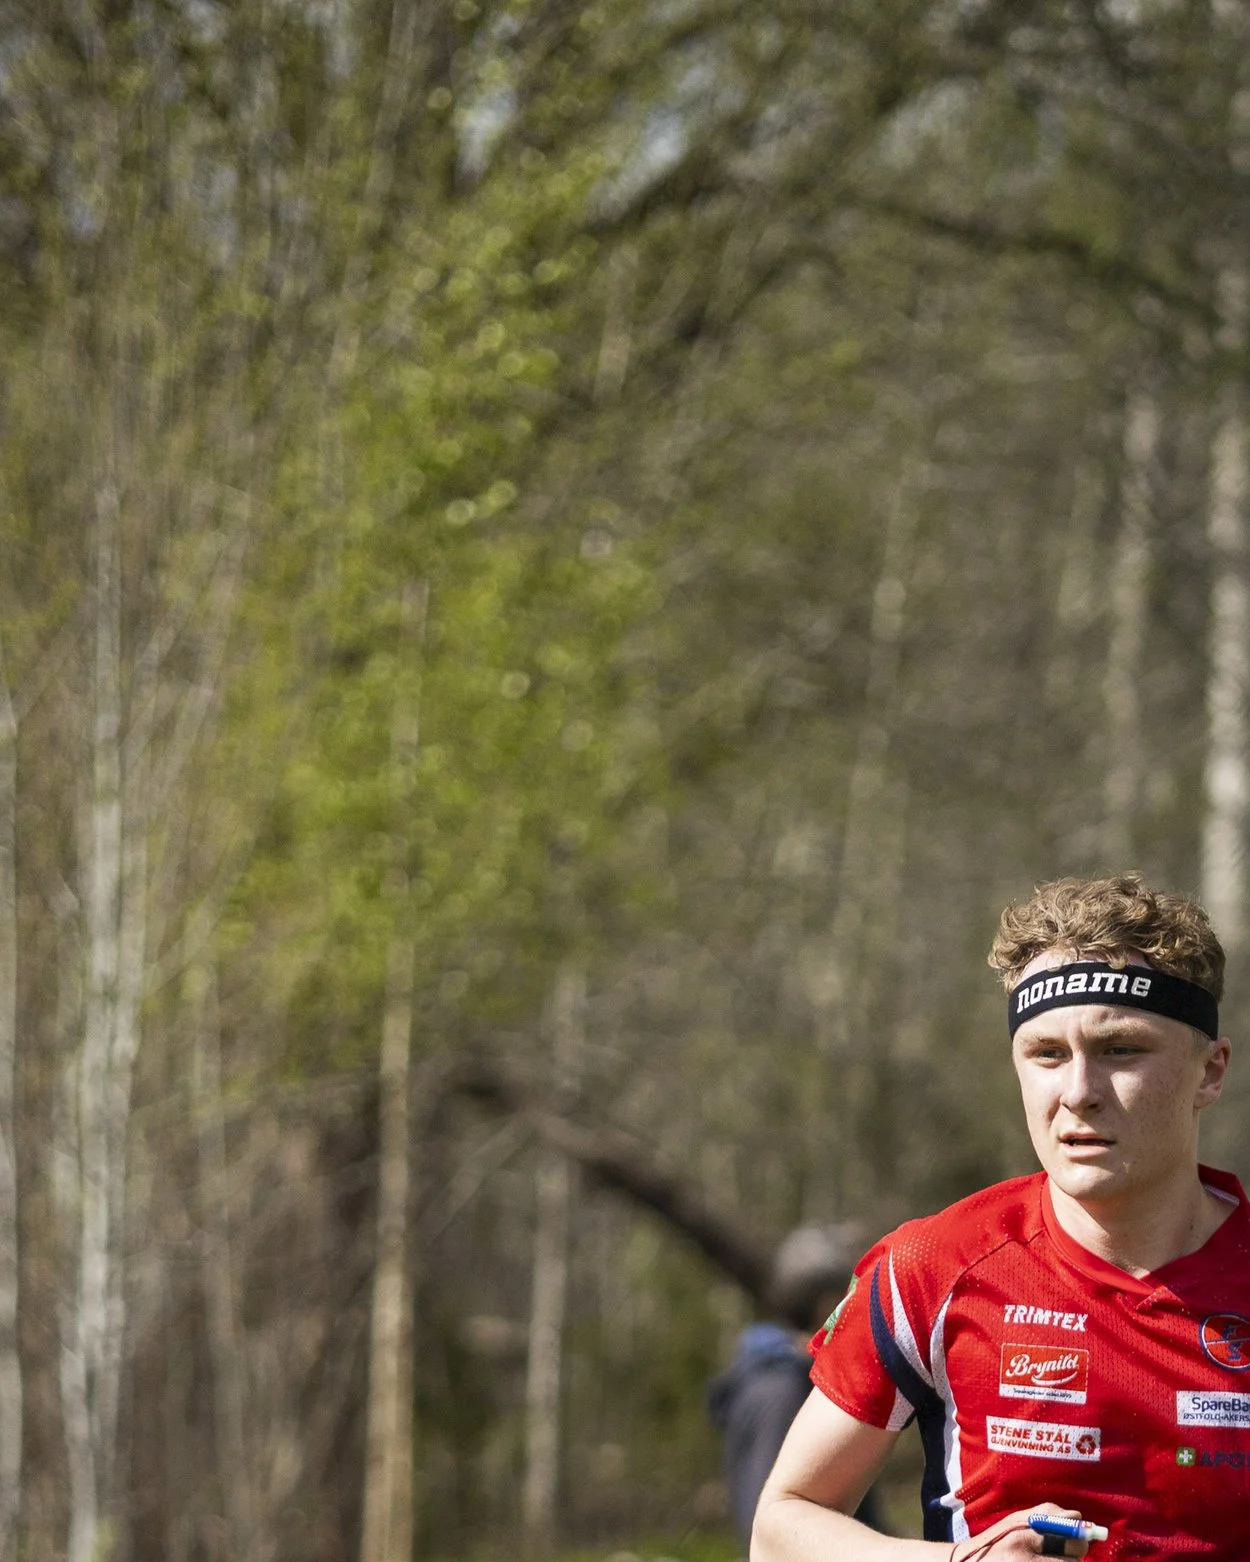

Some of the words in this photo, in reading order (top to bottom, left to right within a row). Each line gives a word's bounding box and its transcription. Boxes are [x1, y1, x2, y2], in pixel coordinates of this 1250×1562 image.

[1016, 972, 1151, 1013] noname
[1003, 1304, 1088, 1332] TRIMTEX
[1005, 1353, 1079, 1386] Brynild
[991, 1425, 1032, 1440] STENE
[1035, 1428, 1071, 1444] STÅL
[991, 1437, 1054, 1452] GJENVINNING
[1057, 1445, 1071, 1454] AS
